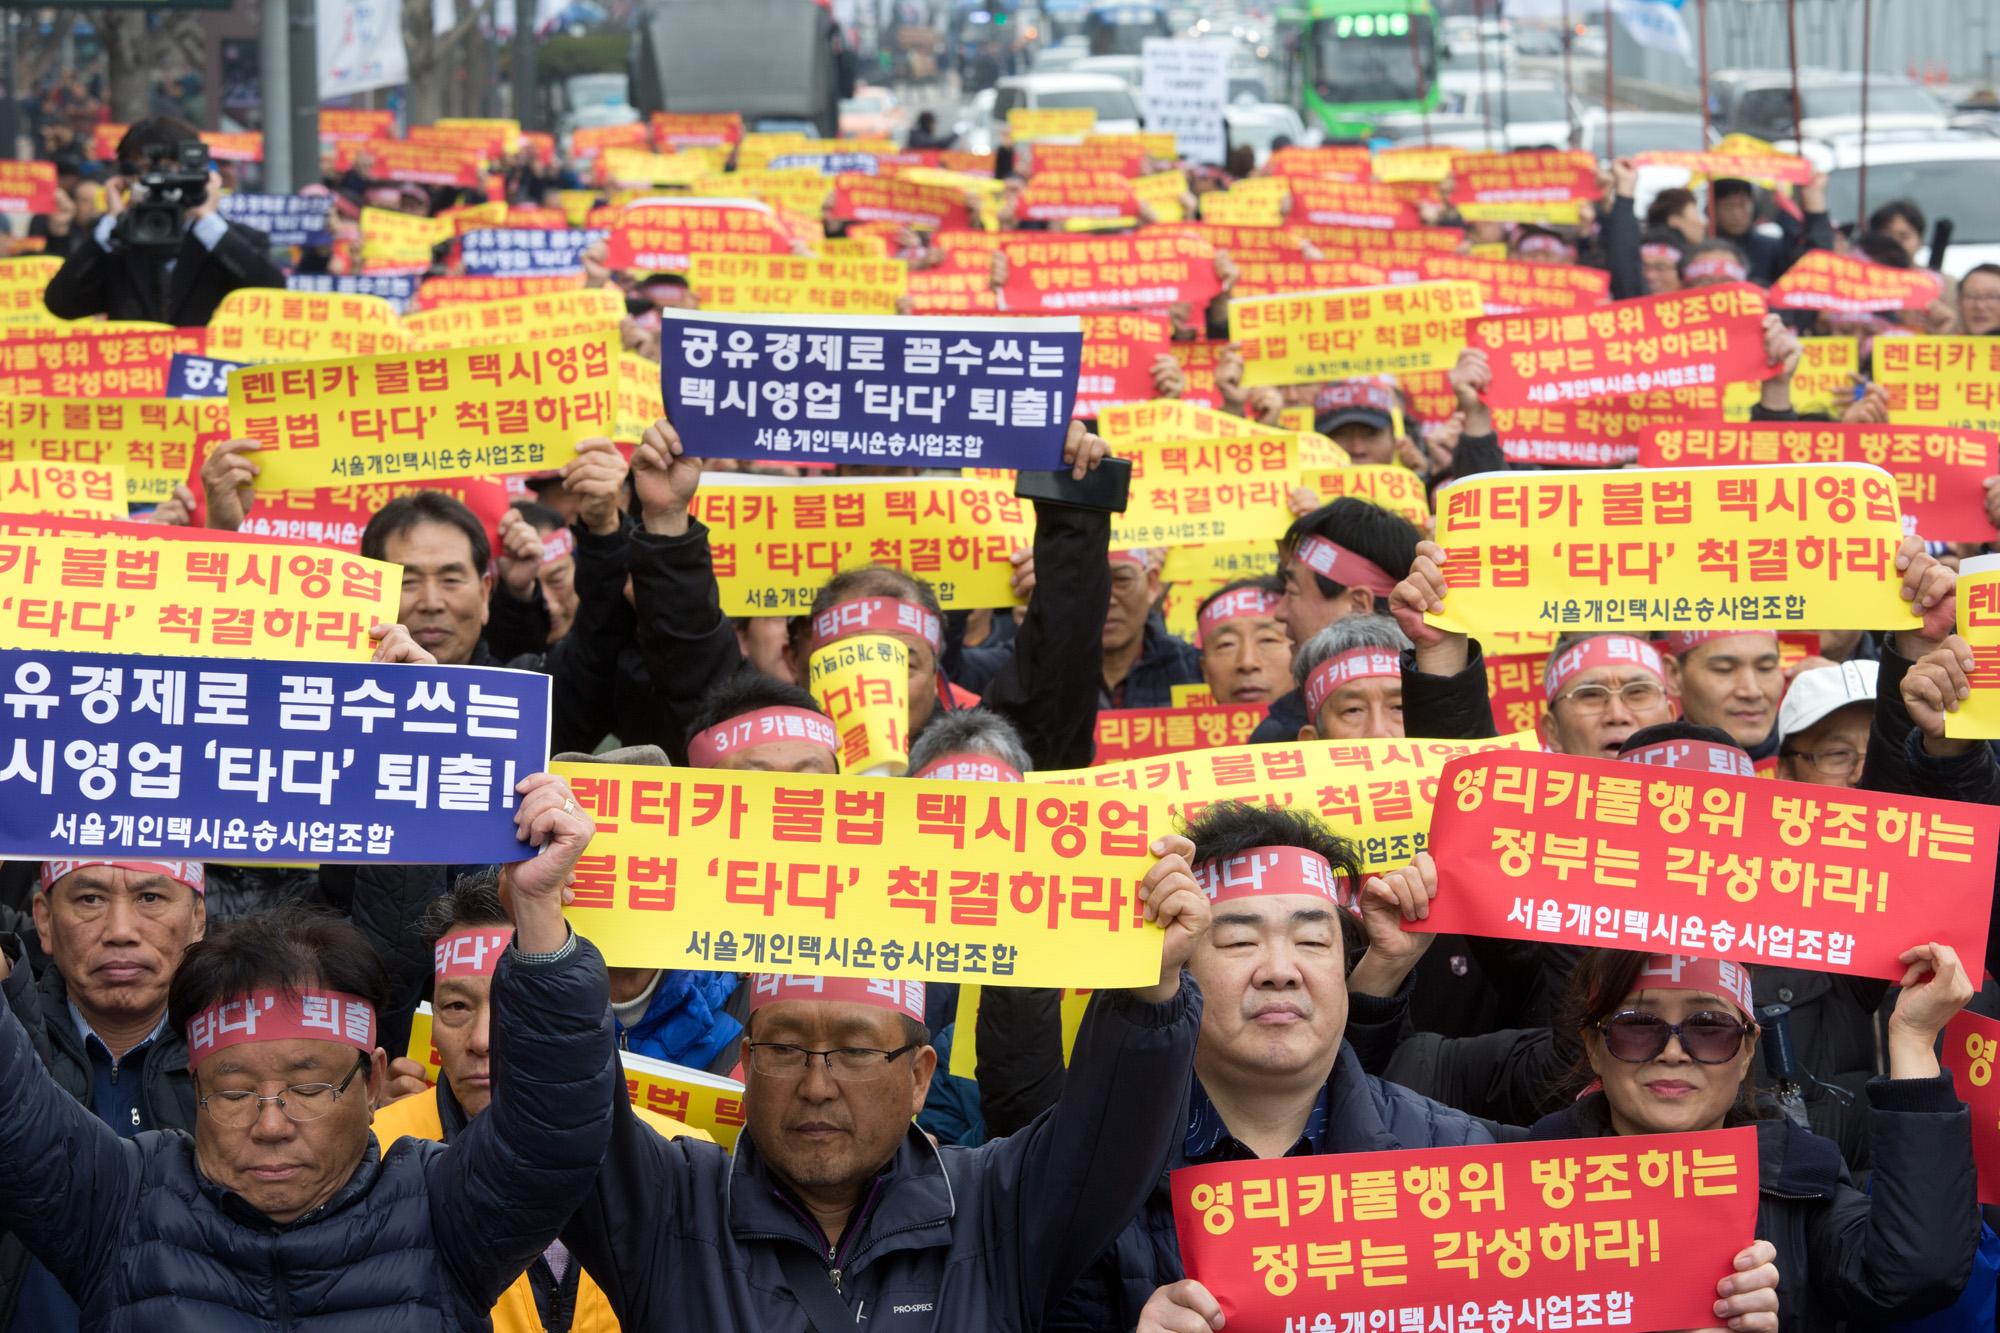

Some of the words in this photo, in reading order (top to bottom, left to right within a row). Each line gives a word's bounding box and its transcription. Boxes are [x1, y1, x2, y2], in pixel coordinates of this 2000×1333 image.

[241, 364, 360, 405] 렌터카
[374, 356, 450, 396] 불법
[467, 340, 610, 388] 택시영업
[681, 327, 886, 372] 공유경제로
[903, 336, 1065, 378] 꼼수쓰는
[1511, 347, 1595, 379] 정부는
[63, 402, 124, 430] 불법
[244, 412, 321, 453] 불법
[337, 404, 438, 443] '타다'
[455, 389, 613, 437] 척결하라!
[678, 376, 841, 421] 택시영업
[854, 379, 957, 424] '타다'
[968, 387, 1063, 428] 퇴출!
[126, 438, 197, 470] 척결
[331, 443, 546, 477] 서울개인택시운송사업조합
[753, 427, 984, 459] 서울개인택시운송사업조합
[1117, 448, 1146, 480] 법
[1160, 440, 1288, 478] 택시영업
[1858, 432, 1988, 468] 방조하는
[792, 492, 867, 530] 불법
[884, 487, 1026, 525] 택시영업
[1446, 483, 1584, 533] 렌터카
[1601, 479, 1693, 526] 불법
[1716, 473, 1897, 525] 택시영업
[60, 547, 161, 591] 불법
[185, 551, 384, 604] 택시영업
[755, 540, 854, 578] '타다'
[1440, 543, 1531, 591] 불법
[1551, 540, 1676, 586] '타다'
[1, 596, 136, 641] '타다'
[813, 600, 883, 638] '타다'
[1539, 593, 1807, 625] 서울개인택시운송사업조합
[278, 673, 521, 740] 꼼수쓰는
[714, 721, 753, 752] 3/7
[759, 714, 837, 749] 카풀합의
[0, 737, 184, 801] 시영업
[203, 739, 356, 807] '타다'
[374, 752, 517, 812] 퇴출!
[1210, 748, 1307, 788] 불법
[49, 811, 395, 856] 서울개인택시운송사업조합
[571, 777, 749, 841] 렌터카
[771, 786, 886, 846] 불법
[915, 792, 1150, 860] 택시영업
[1452, 765, 1747, 838] 영리카풀행위
[1770, 795, 1976, 864] 방조하는
[571, 854, 679, 912] 불법
[707, 856, 862, 922] '타다'
[886, 865, 1144, 932] 척결하라!
[1490, 826, 1641, 889] 정부는
[1665, 846, 1890, 914] 각성하라!
[684, 930, 1018, 977] 서울개인택시운송사업조합
[1506, 896, 1857, 966] 서울개인택시운송사업조합
[186, 996, 275, 1049] '타다'
[301, 996, 372, 1046] 퇴출
[1189, 1161, 1507, 1236] 영리카풀행위
[1530, 1146, 1739, 1211] 방조하는
[1251, 1235, 1410, 1298] 정부는
[1431, 1218, 1662, 1281] 각성하라!
